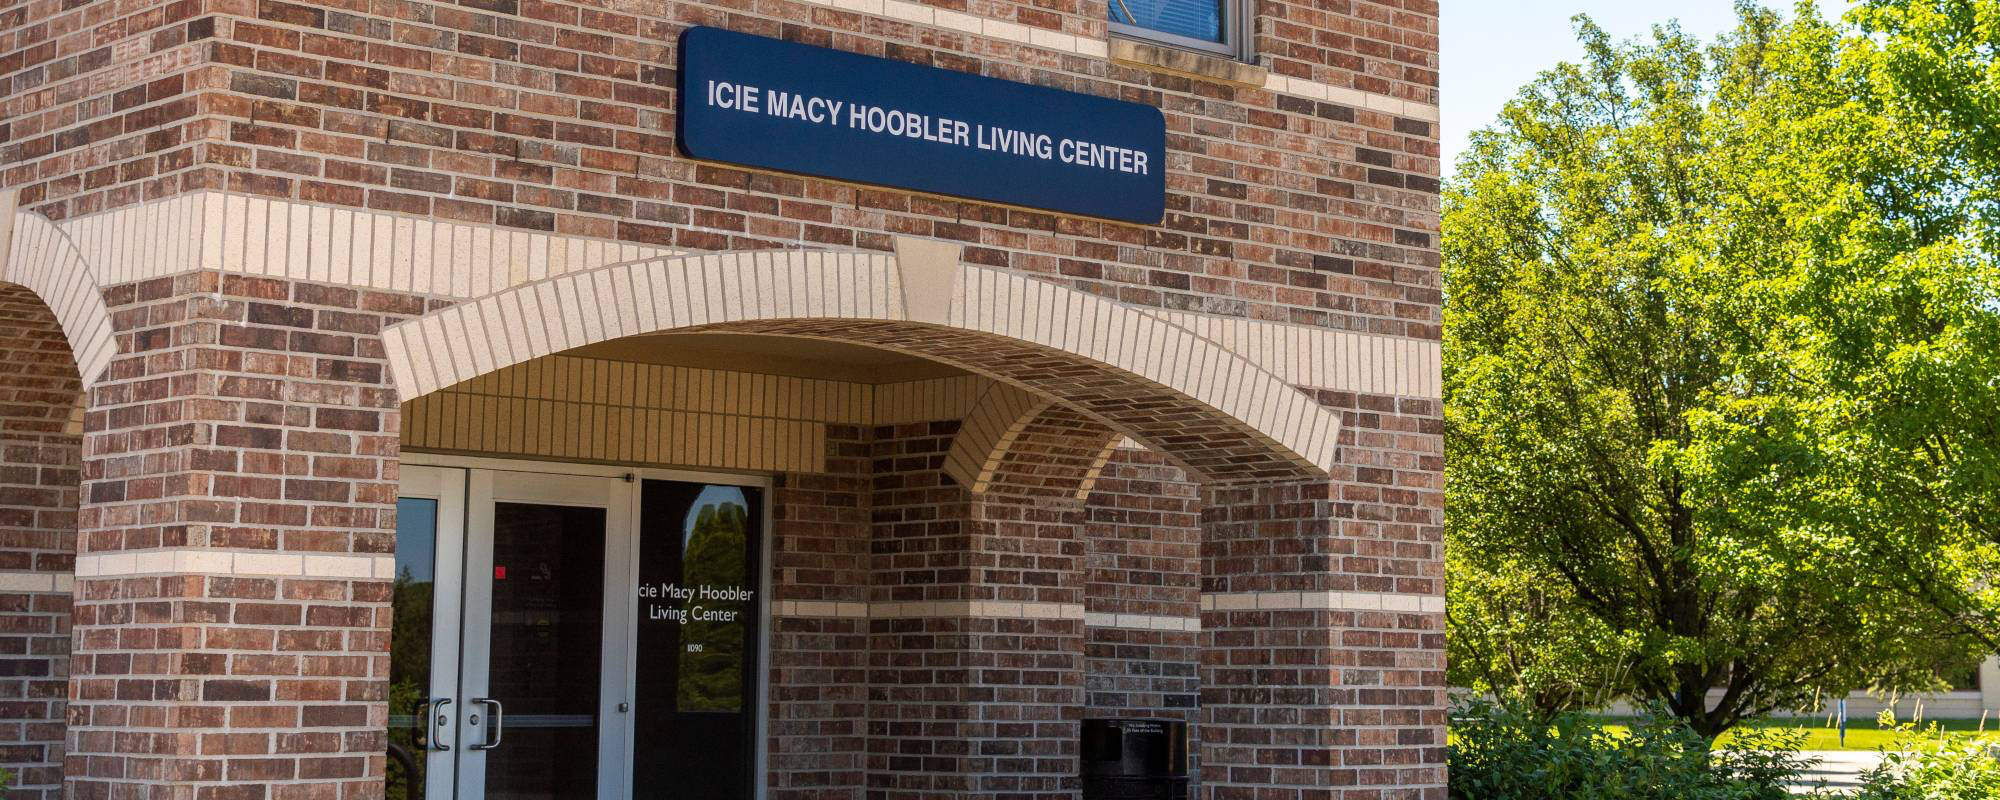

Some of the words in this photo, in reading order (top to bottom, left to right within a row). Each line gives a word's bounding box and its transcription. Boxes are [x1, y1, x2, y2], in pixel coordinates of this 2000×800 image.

[708, 79, 759, 113] ICIE
[767, 89, 843, 126] MACY
[849, 103, 970, 147] HOOBLER
[977, 124, 1053, 160] LIVING
[1059, 138, 1148, 175] CENTER
[638, 583, 657, 598] cie
[661, 583, 696, 603] Macy
[699, 584, 754, 601] Hoobler
[650, 604, 688, 625] Living
[691, 605, 738, 622] Center
